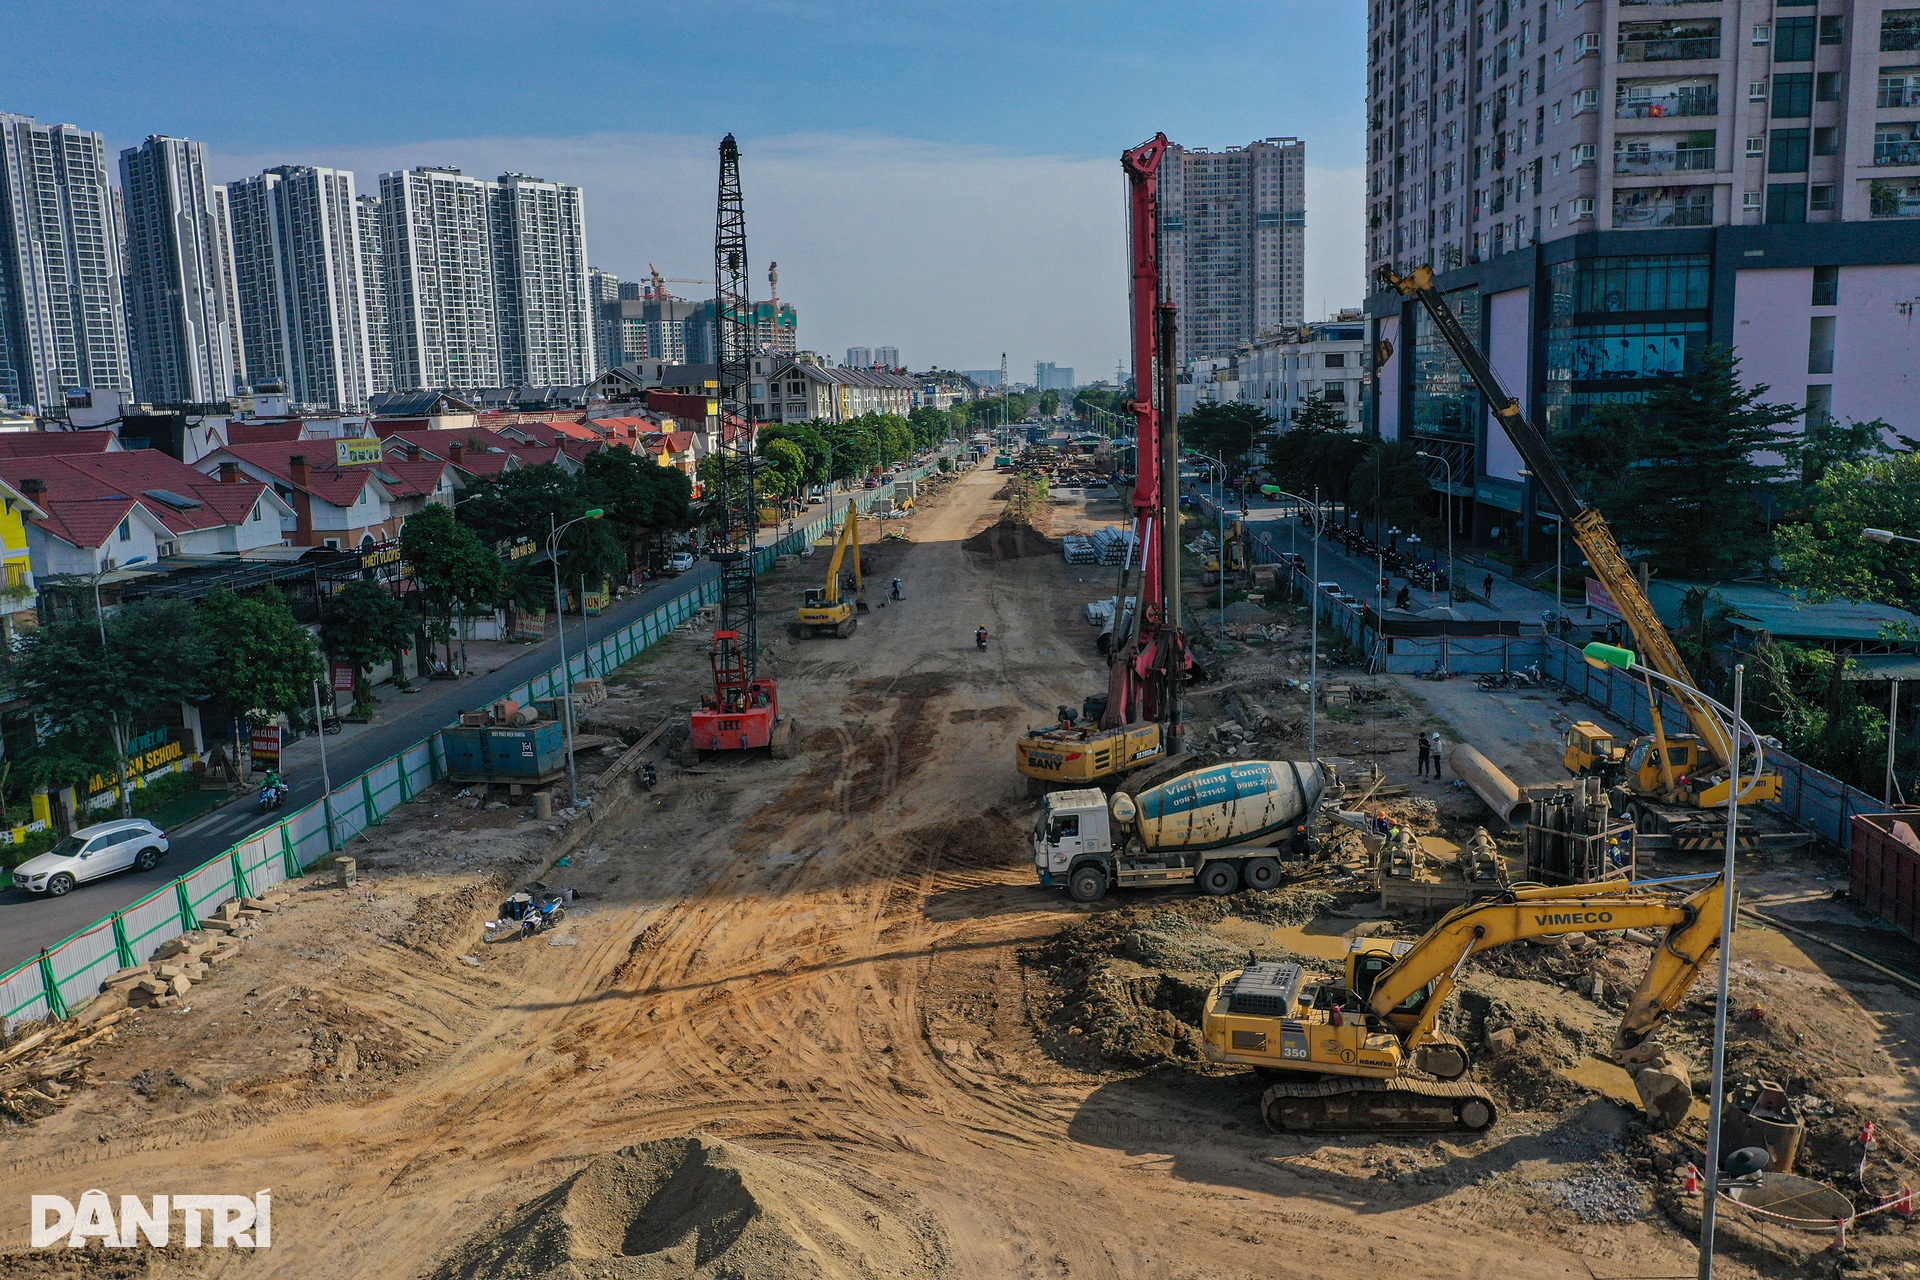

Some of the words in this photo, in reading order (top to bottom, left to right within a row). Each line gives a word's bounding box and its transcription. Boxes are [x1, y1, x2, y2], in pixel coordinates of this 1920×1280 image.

[146, 741, 183, 769] SCHOOL
[1028, 757, 1063, 771] SANY
[1192, 774, 1226, 788] Hung
[1533, 911, 1613, 927] VIMECO
[1284, 1047, 1307, 1058] 350
[1359, 1058, 1393, 1067] KOMATSU
